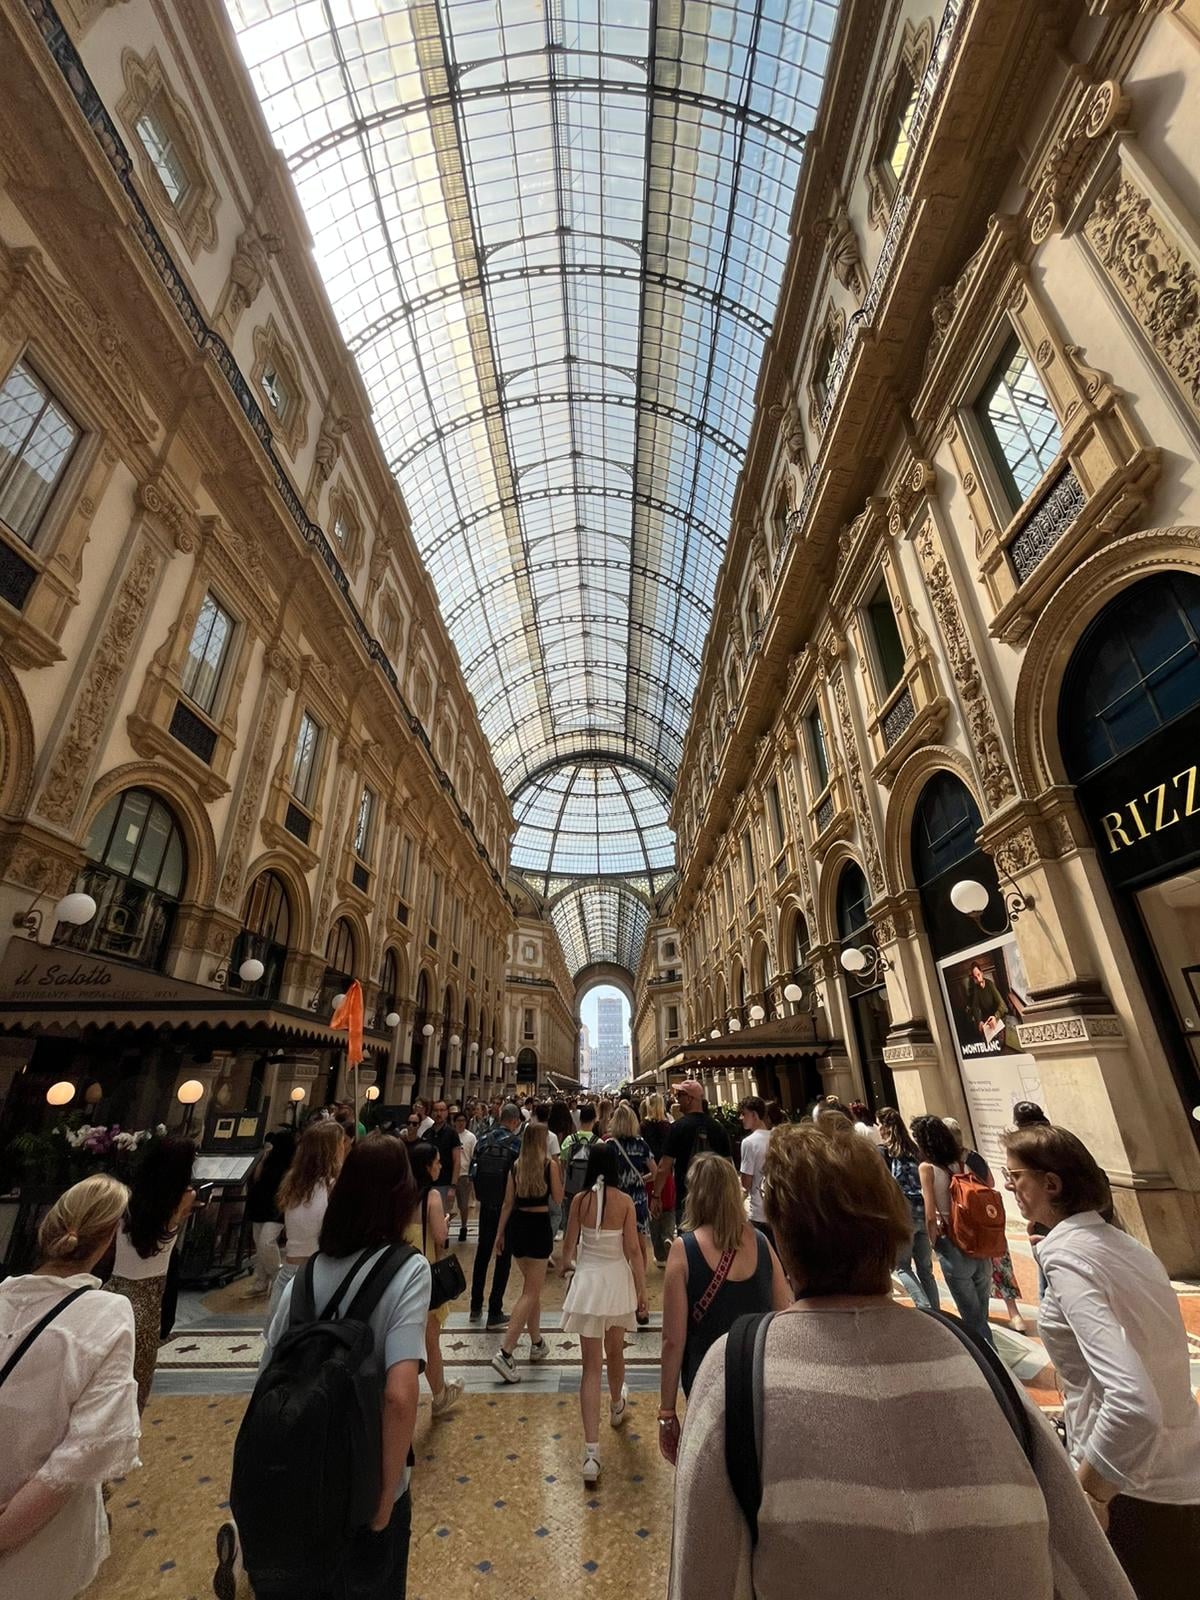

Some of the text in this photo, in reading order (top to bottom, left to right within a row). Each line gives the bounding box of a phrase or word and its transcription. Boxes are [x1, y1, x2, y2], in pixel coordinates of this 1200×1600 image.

[1100, 766, 1200, 854] RIZZ
[15, 964, 112, 985] il Salotto
[962, 1040, 1001, 1055] MONTBLANC
